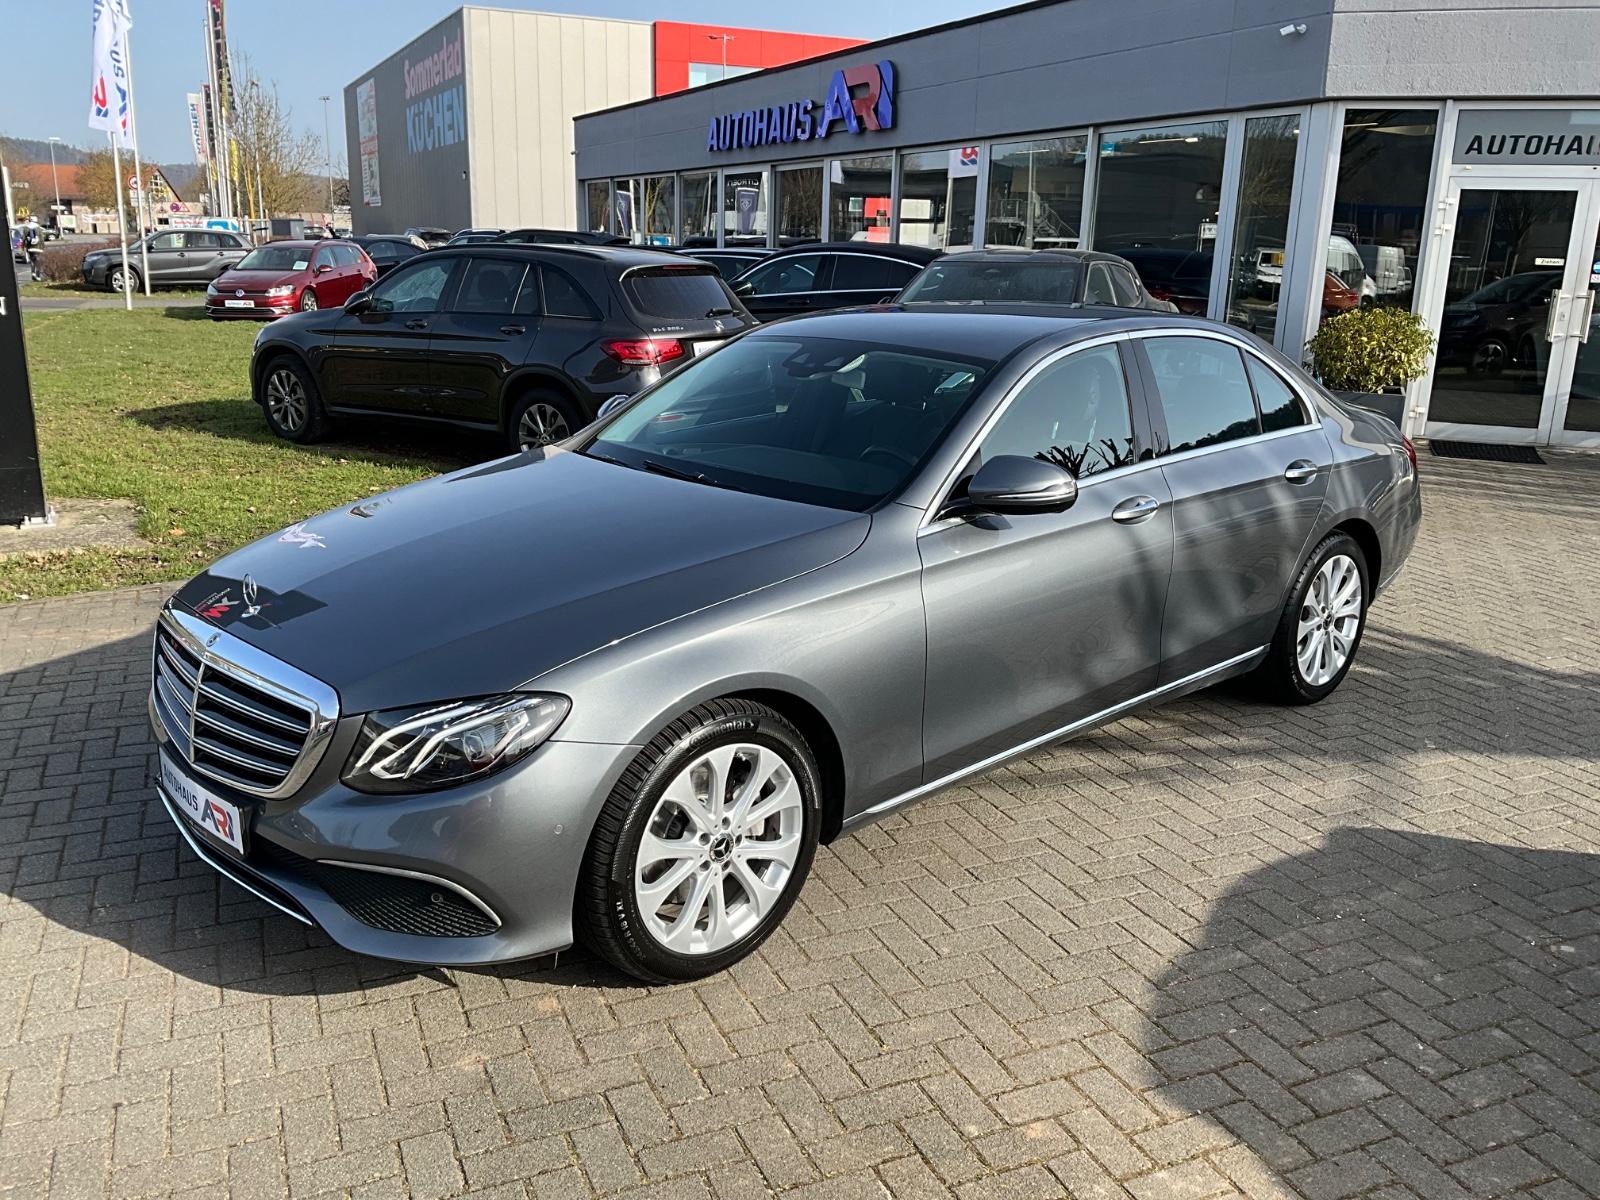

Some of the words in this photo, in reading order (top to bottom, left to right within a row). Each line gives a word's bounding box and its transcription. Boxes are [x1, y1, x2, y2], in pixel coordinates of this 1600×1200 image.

[404, 28, 462, 100] Sommerlad
[406, 85, 465, 155] KÜCHEN
[708, 100, 814, 152] AUTOHAUS
[816, 60, 896, 138] ARI
[163, 763, 199, 812] AUTOHAUS
[201, 798, 236, 842] ARI
